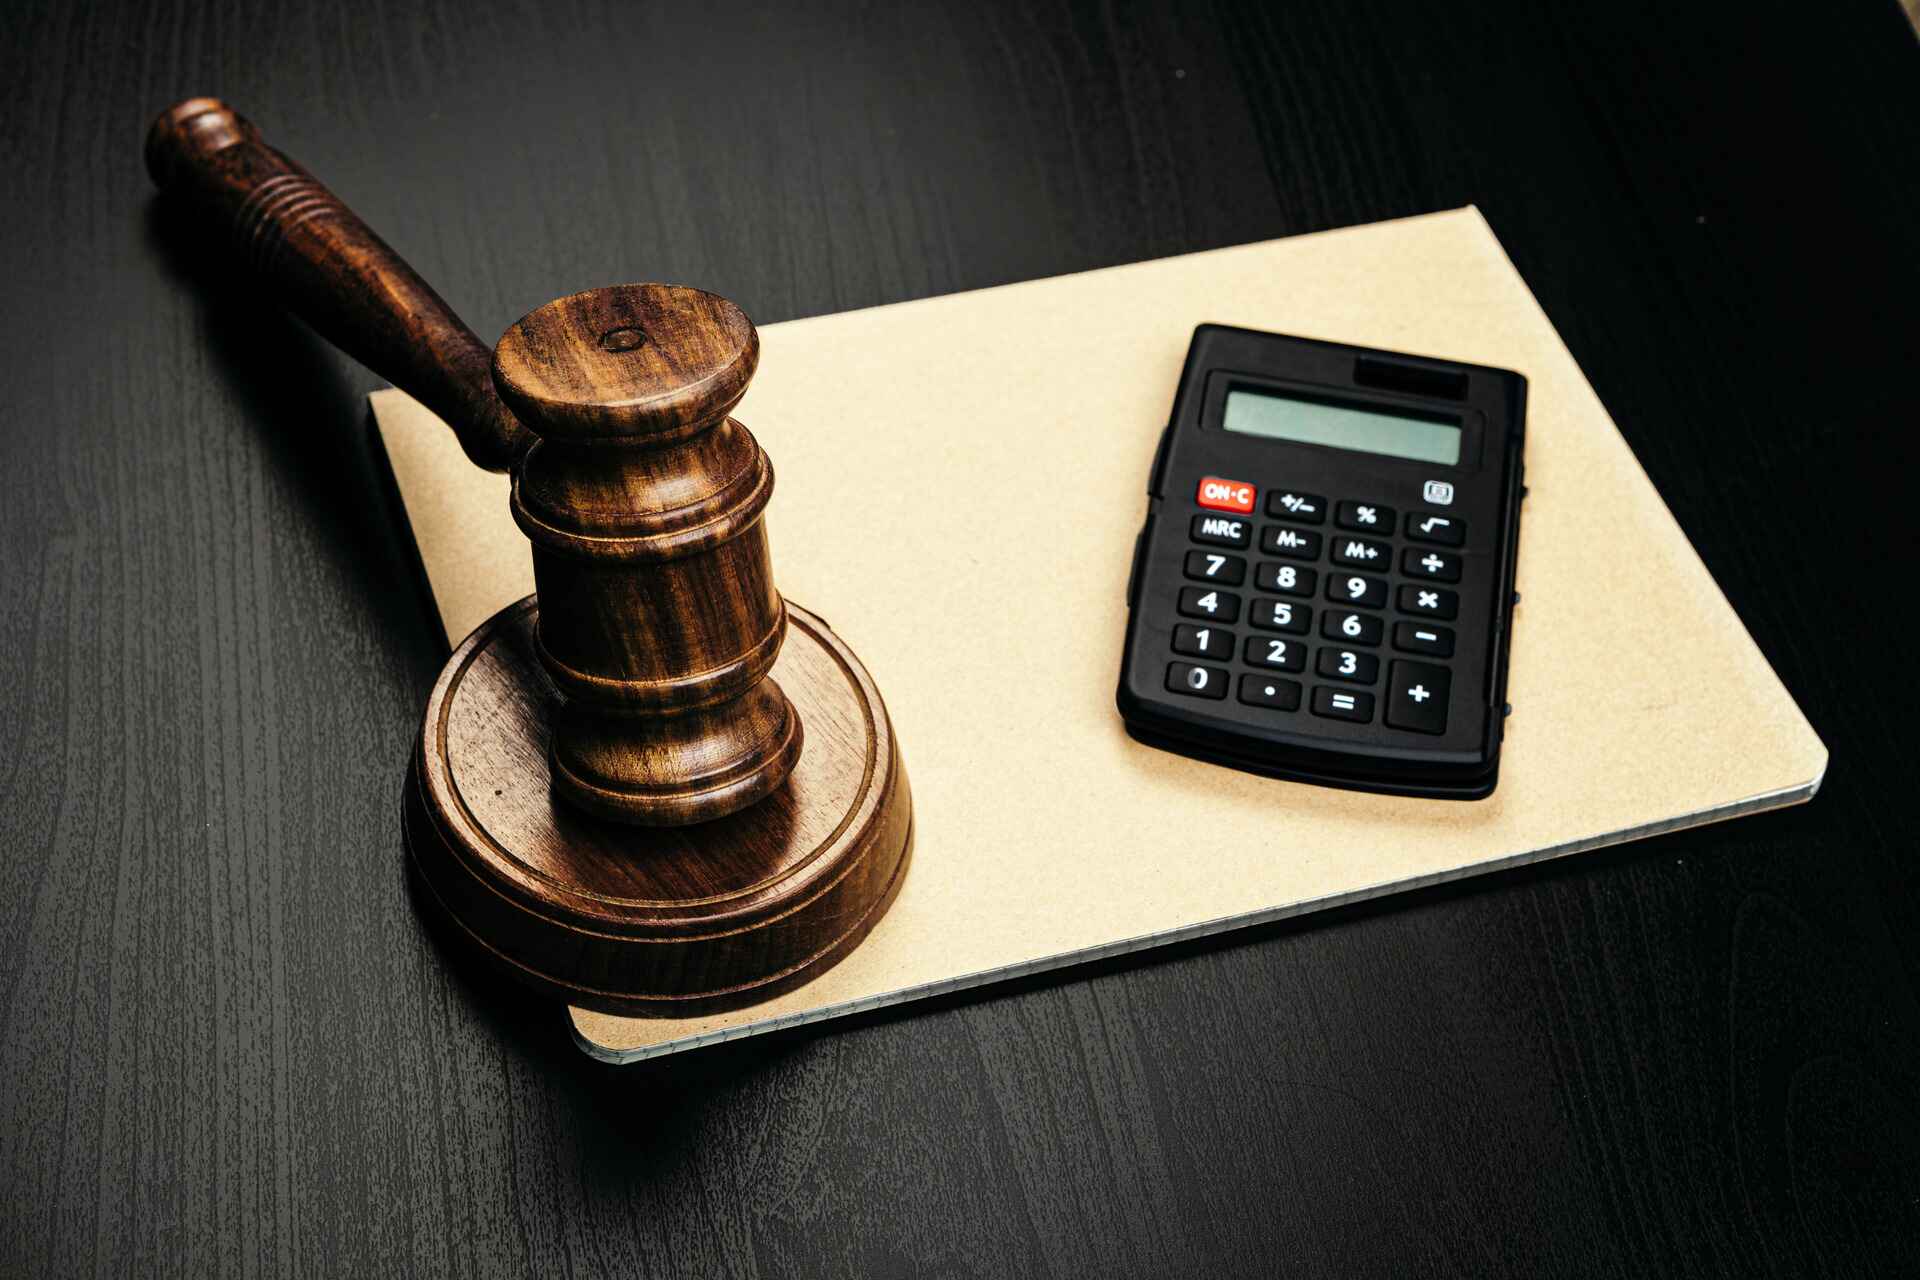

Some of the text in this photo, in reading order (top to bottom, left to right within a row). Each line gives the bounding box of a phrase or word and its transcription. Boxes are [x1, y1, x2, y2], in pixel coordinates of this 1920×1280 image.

[1357, 507, 1376, 523] %
[1202, 519, 1241, 538] MRC
[1346, 542, 1377, 558] M+
[1206, 555, 1225, 575] 7
[1277, 567, 1296, 587] 8
[1348, 578, 1366, 598] 9
[1198, 592, 1217, 612] 4
[1273, 603, 1291, 624] 5
[1343, 615, 1361, 635] 6
[1197, 630, 1209, 650] 1
[1267, 641, 1286, 662] 2
[1339, 652, 1356, 673] 3
[1189, 668, 1208, 689] 0
[1333, 694, 1354, 709] =
[1408, 685, 1429, 702] +
